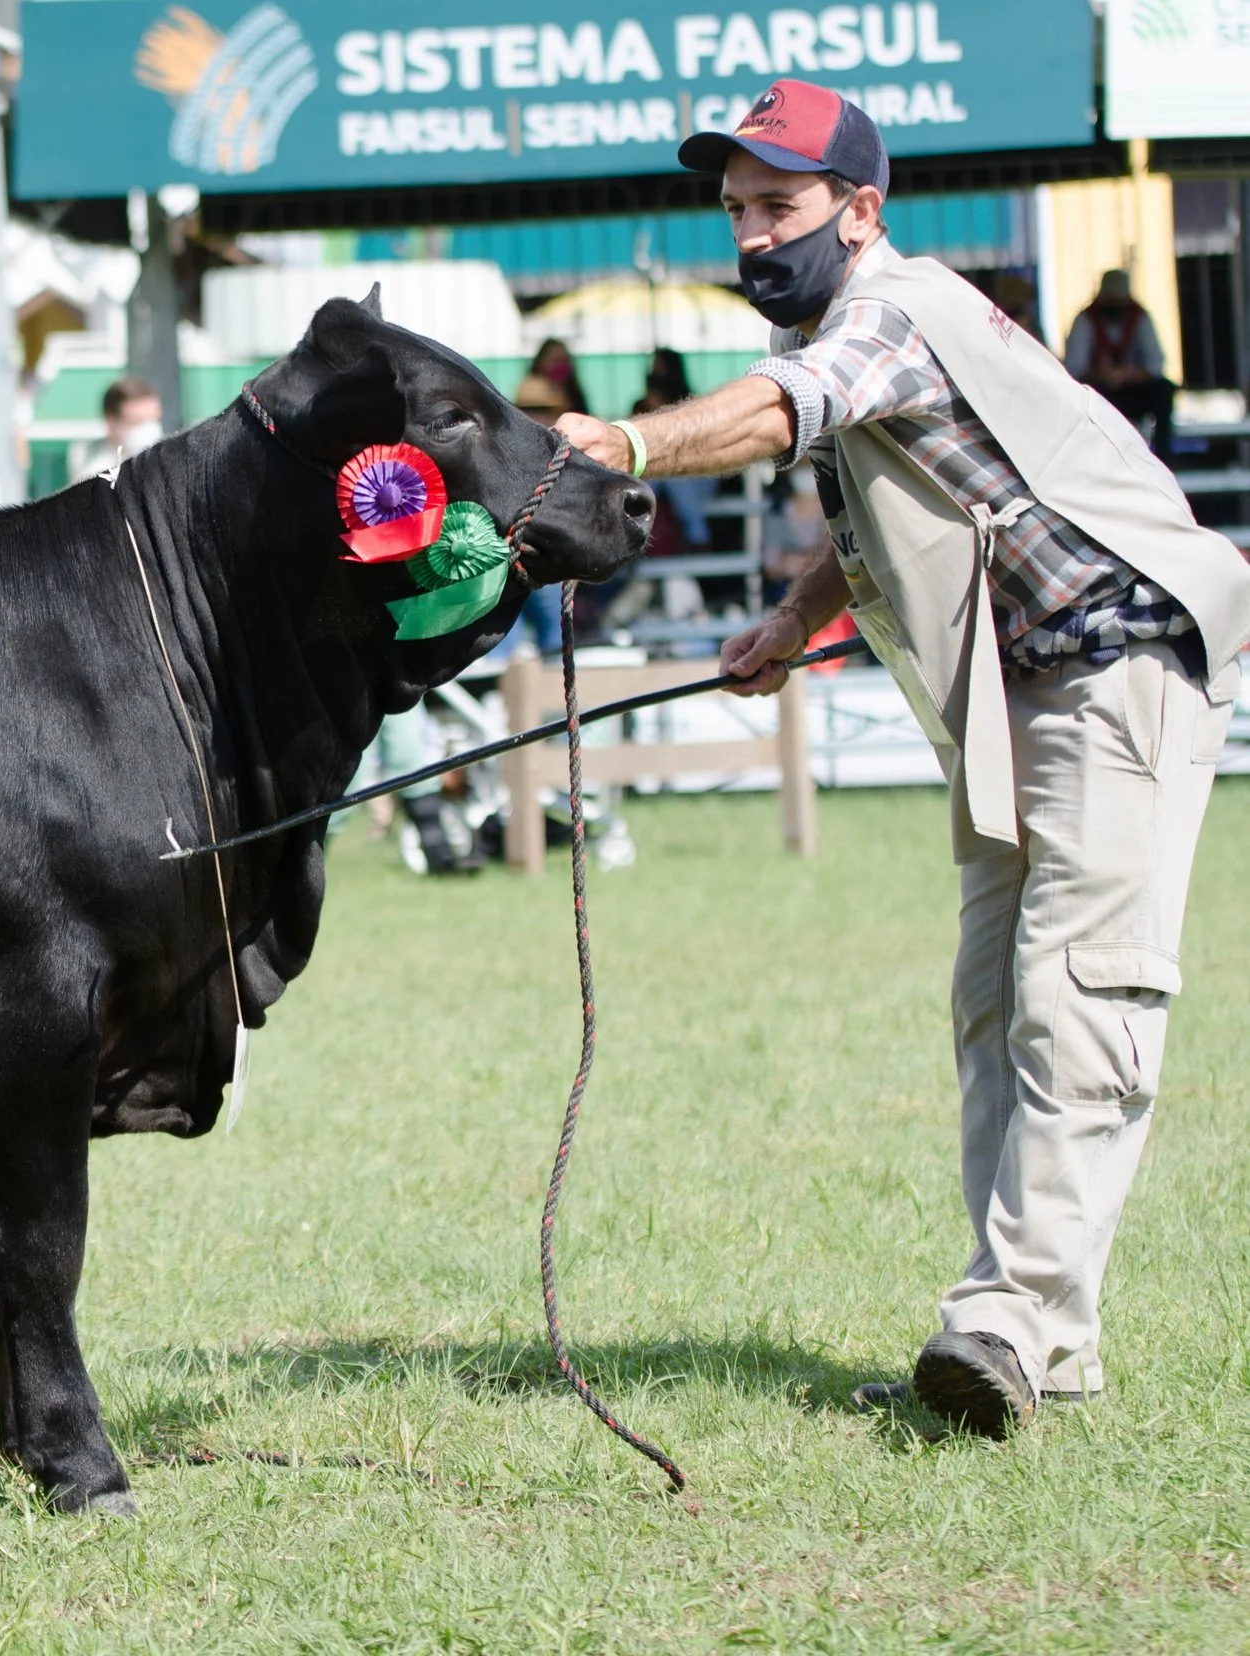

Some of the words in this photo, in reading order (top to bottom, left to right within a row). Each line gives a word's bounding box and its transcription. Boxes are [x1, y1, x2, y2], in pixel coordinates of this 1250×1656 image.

[336, 20, 662, 96] SISTEMA
[675, 1, 963, 84] FARSUL
[339, 108, 507, 156] FARSUL
[523, 97, 677, 149] SENAR
